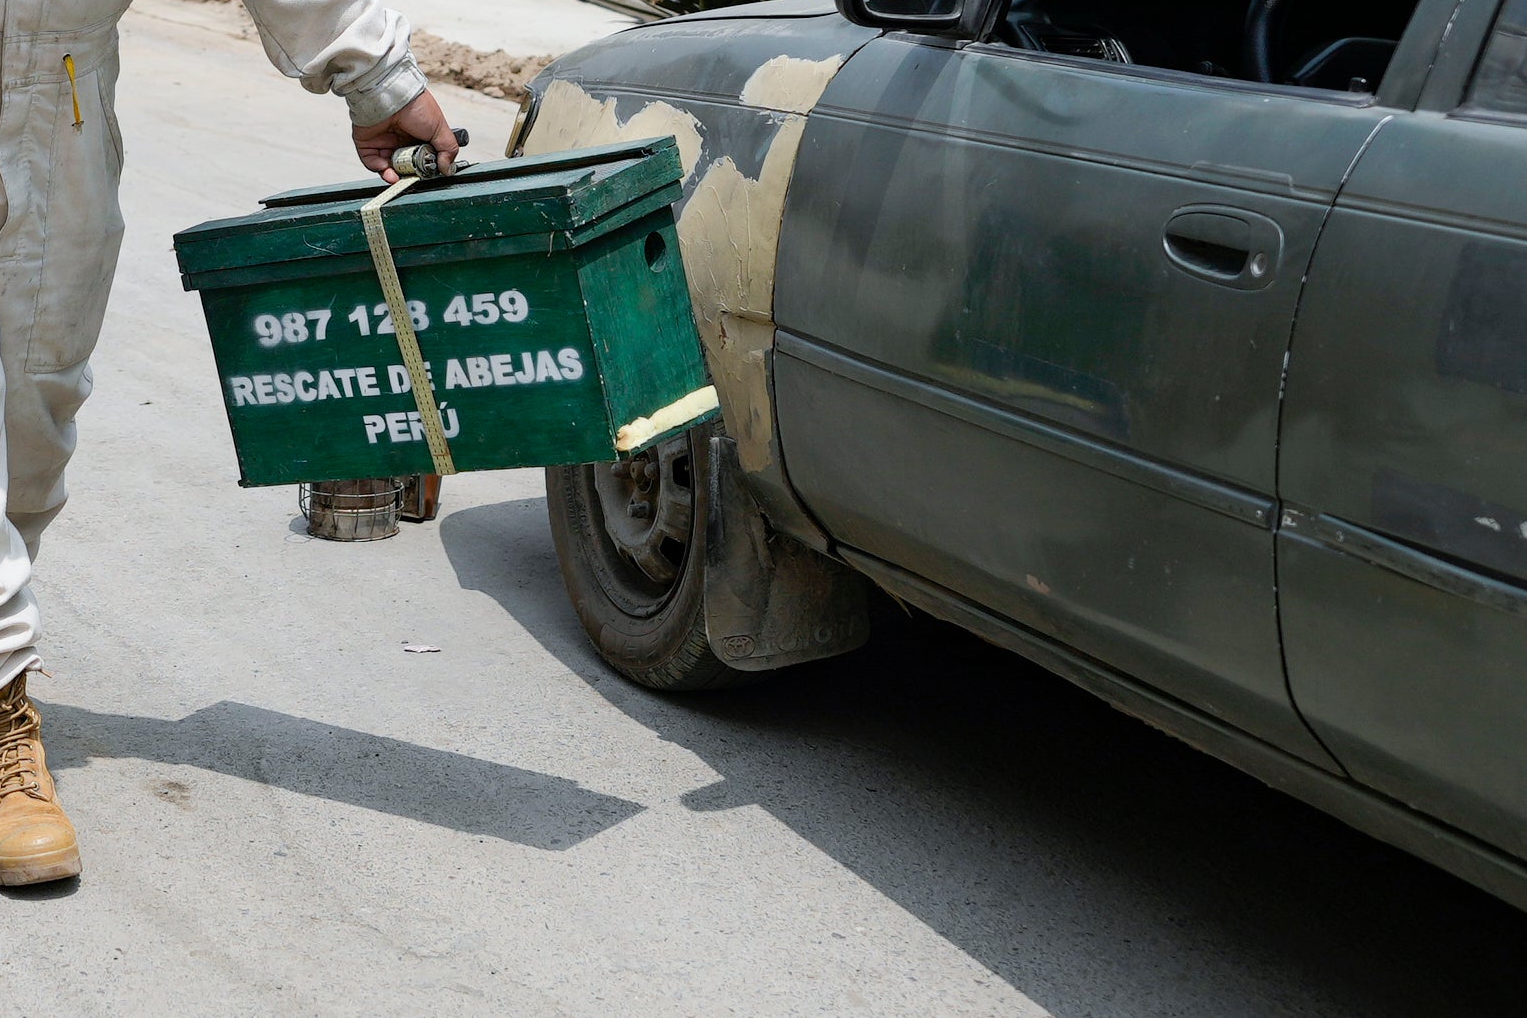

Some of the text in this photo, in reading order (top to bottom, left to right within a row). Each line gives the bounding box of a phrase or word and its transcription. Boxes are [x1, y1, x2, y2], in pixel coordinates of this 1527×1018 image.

[253, 290, 529, 348] 987 128 459
[231, 367, 381, 406] RESCATE
[445, 347, 584, 390] ABEJAS
[362, 401, 460, 444] PERÚ
